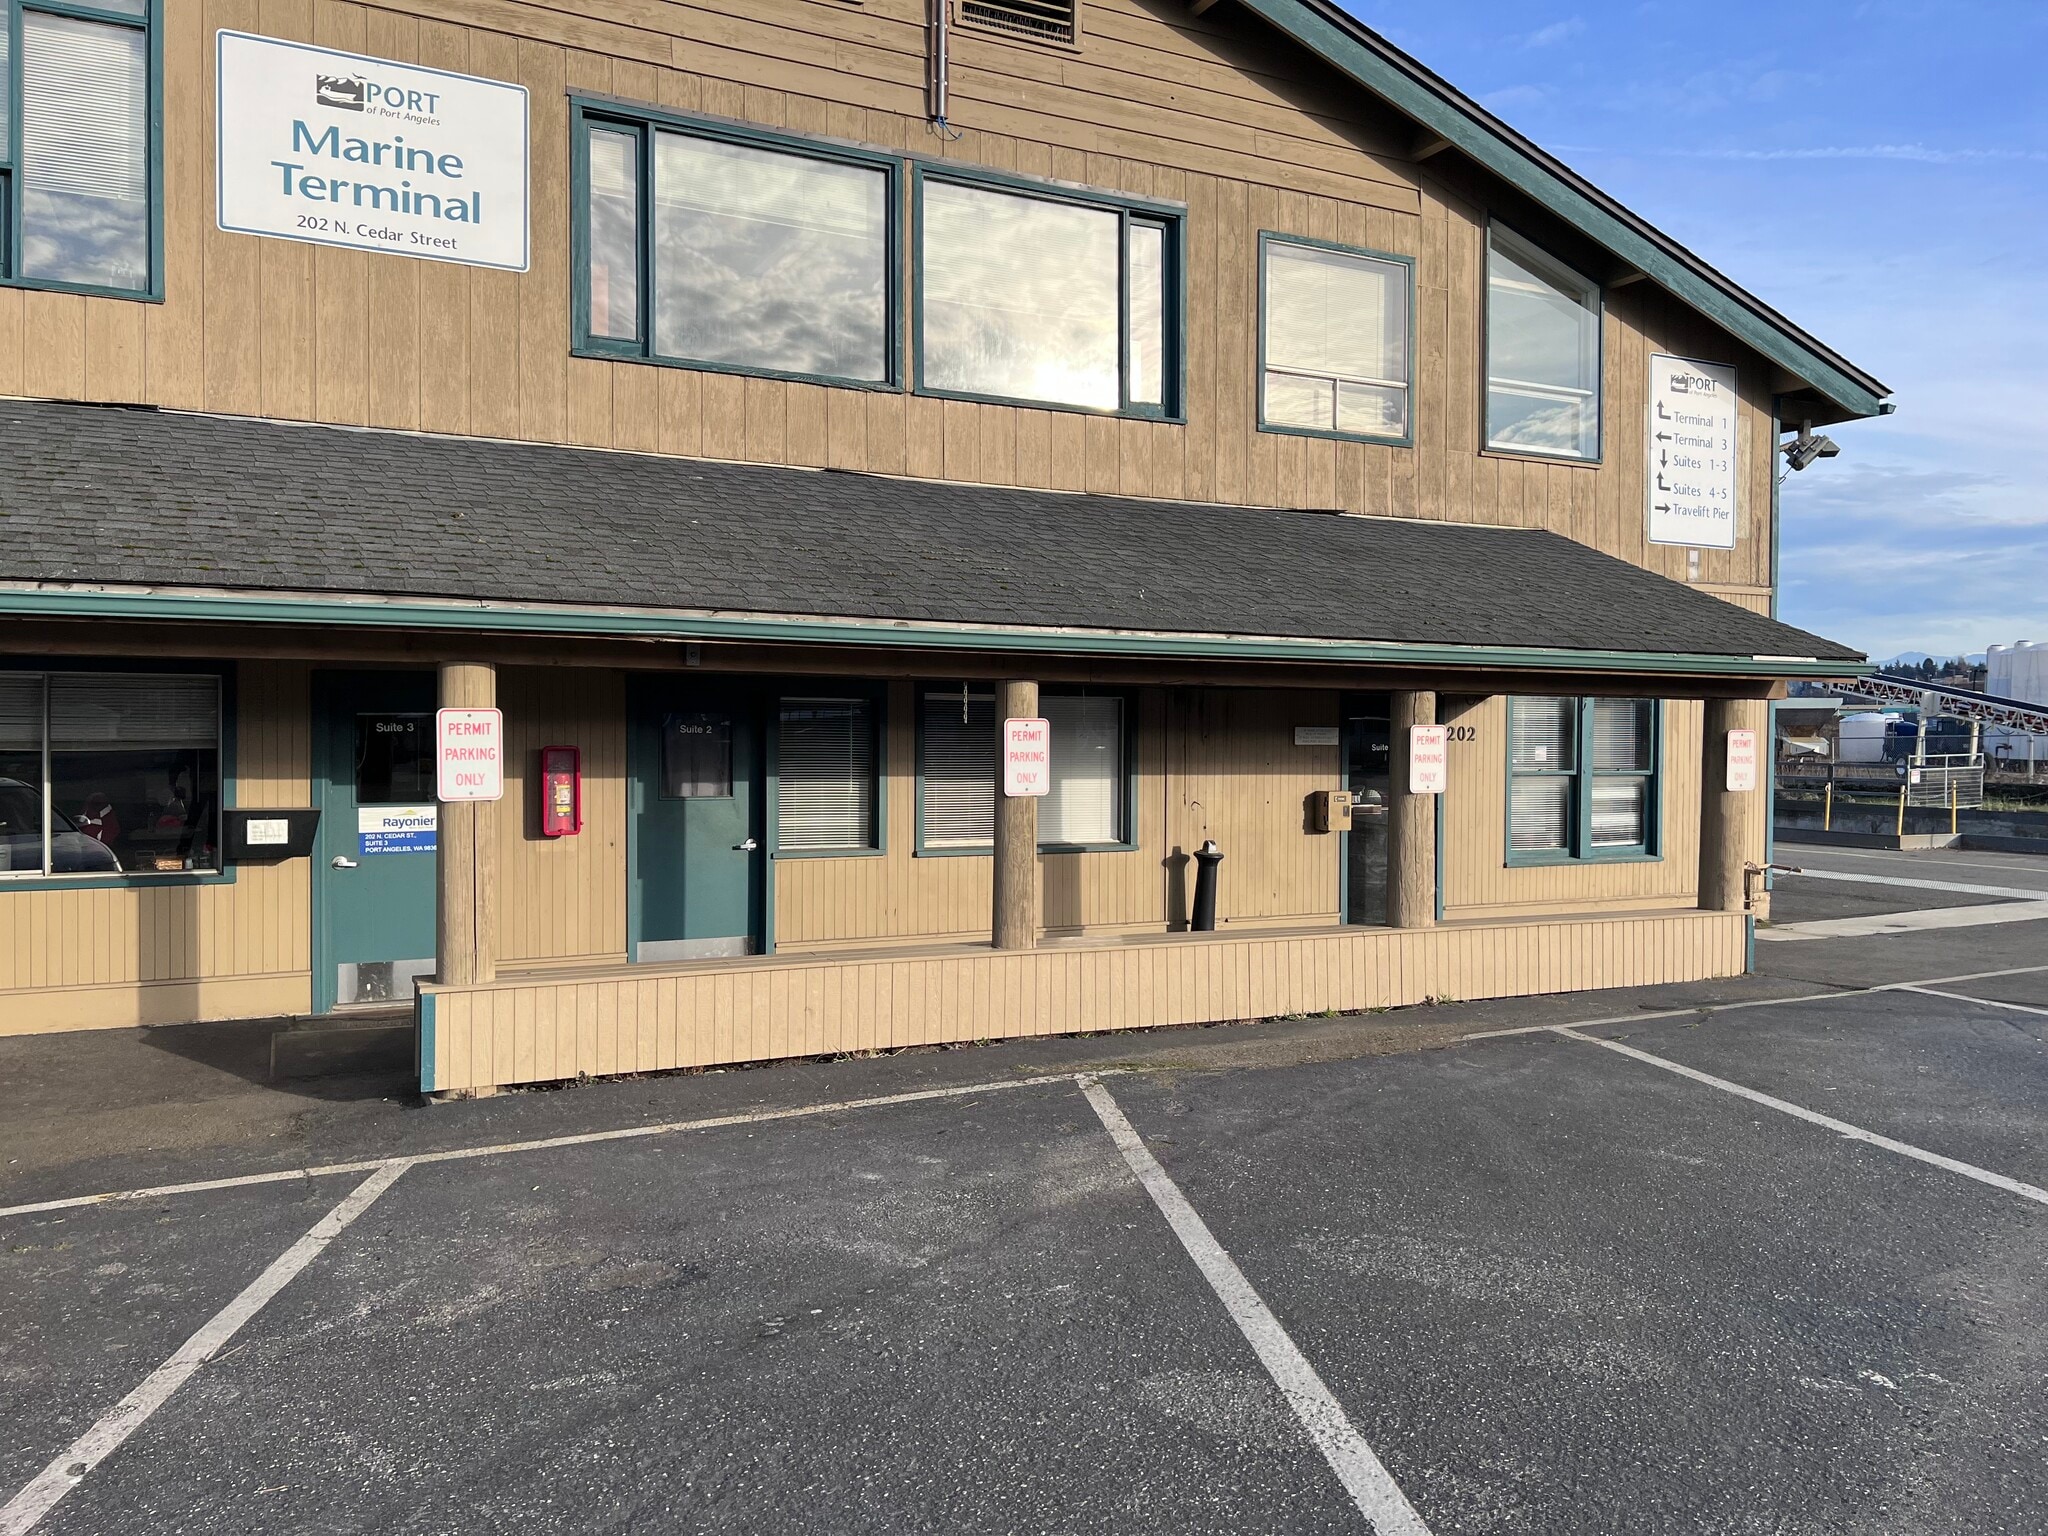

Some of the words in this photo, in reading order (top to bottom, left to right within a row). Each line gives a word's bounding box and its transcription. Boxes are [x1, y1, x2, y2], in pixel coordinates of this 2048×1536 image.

[366, 82, 441, 115] PORT
[366, 106, 377, 115] of
[380, 107, 401, 119] Port
[403, 113, 441, 127] Angeles
[293, 119, 464, 179] Marine
[271, 160, 481, 225] Terminal
[297, 215, 329, 232] 202
[334, 221, 350, 235] N.
[356, 223, 404, 242] Cedar
[410, 231, 458, 250] Street
[1689, 376, 1718, 391] PORT
[1674, 411, 1713, 428] Terminal
[1722, 418, 1727, 429] 1
[1673, 433, 1713, 449] Terminal
[1721, 438, 1728, 450] 3
[1673, 455, 1701, 469] Suites
[1673, 482, 1701, 497] Suites
[1673, 503, 1710, 518] Travelift
[1713, 507, 1730, 520] Pier
[376, 722, 404, 732] Suite
[406, 722, 414, 732] 3
[448, 722, 492, 735] PERMIT
[679, 724, 704, 734] Suite
[706, 725, 712, 734] 2
[1446, 725, 1476, 742] 202
[1011, 730, 1042, 741] PERMIT
[1416, 735, 1441, 745] PERMIT
[1371, 743, 1389, 751] Suite
[1732, 739, 1751, 748] PERMIT
[445, 747, 496, 760] PARKING
[1009, 751, 1045, 762] PARKING
[1414, 753, 1443, 764] PARKING
[1730, 755, 1753, 765] PARKING
[455, 773, 486, 786] ONLY
[1016, 772, 1038, 784] ONLY
[1419, 772, 1437, 782] ONLY
[383, 815, 435, 829] Rayonier
[382, 845, 413, 853] ANGELES,
